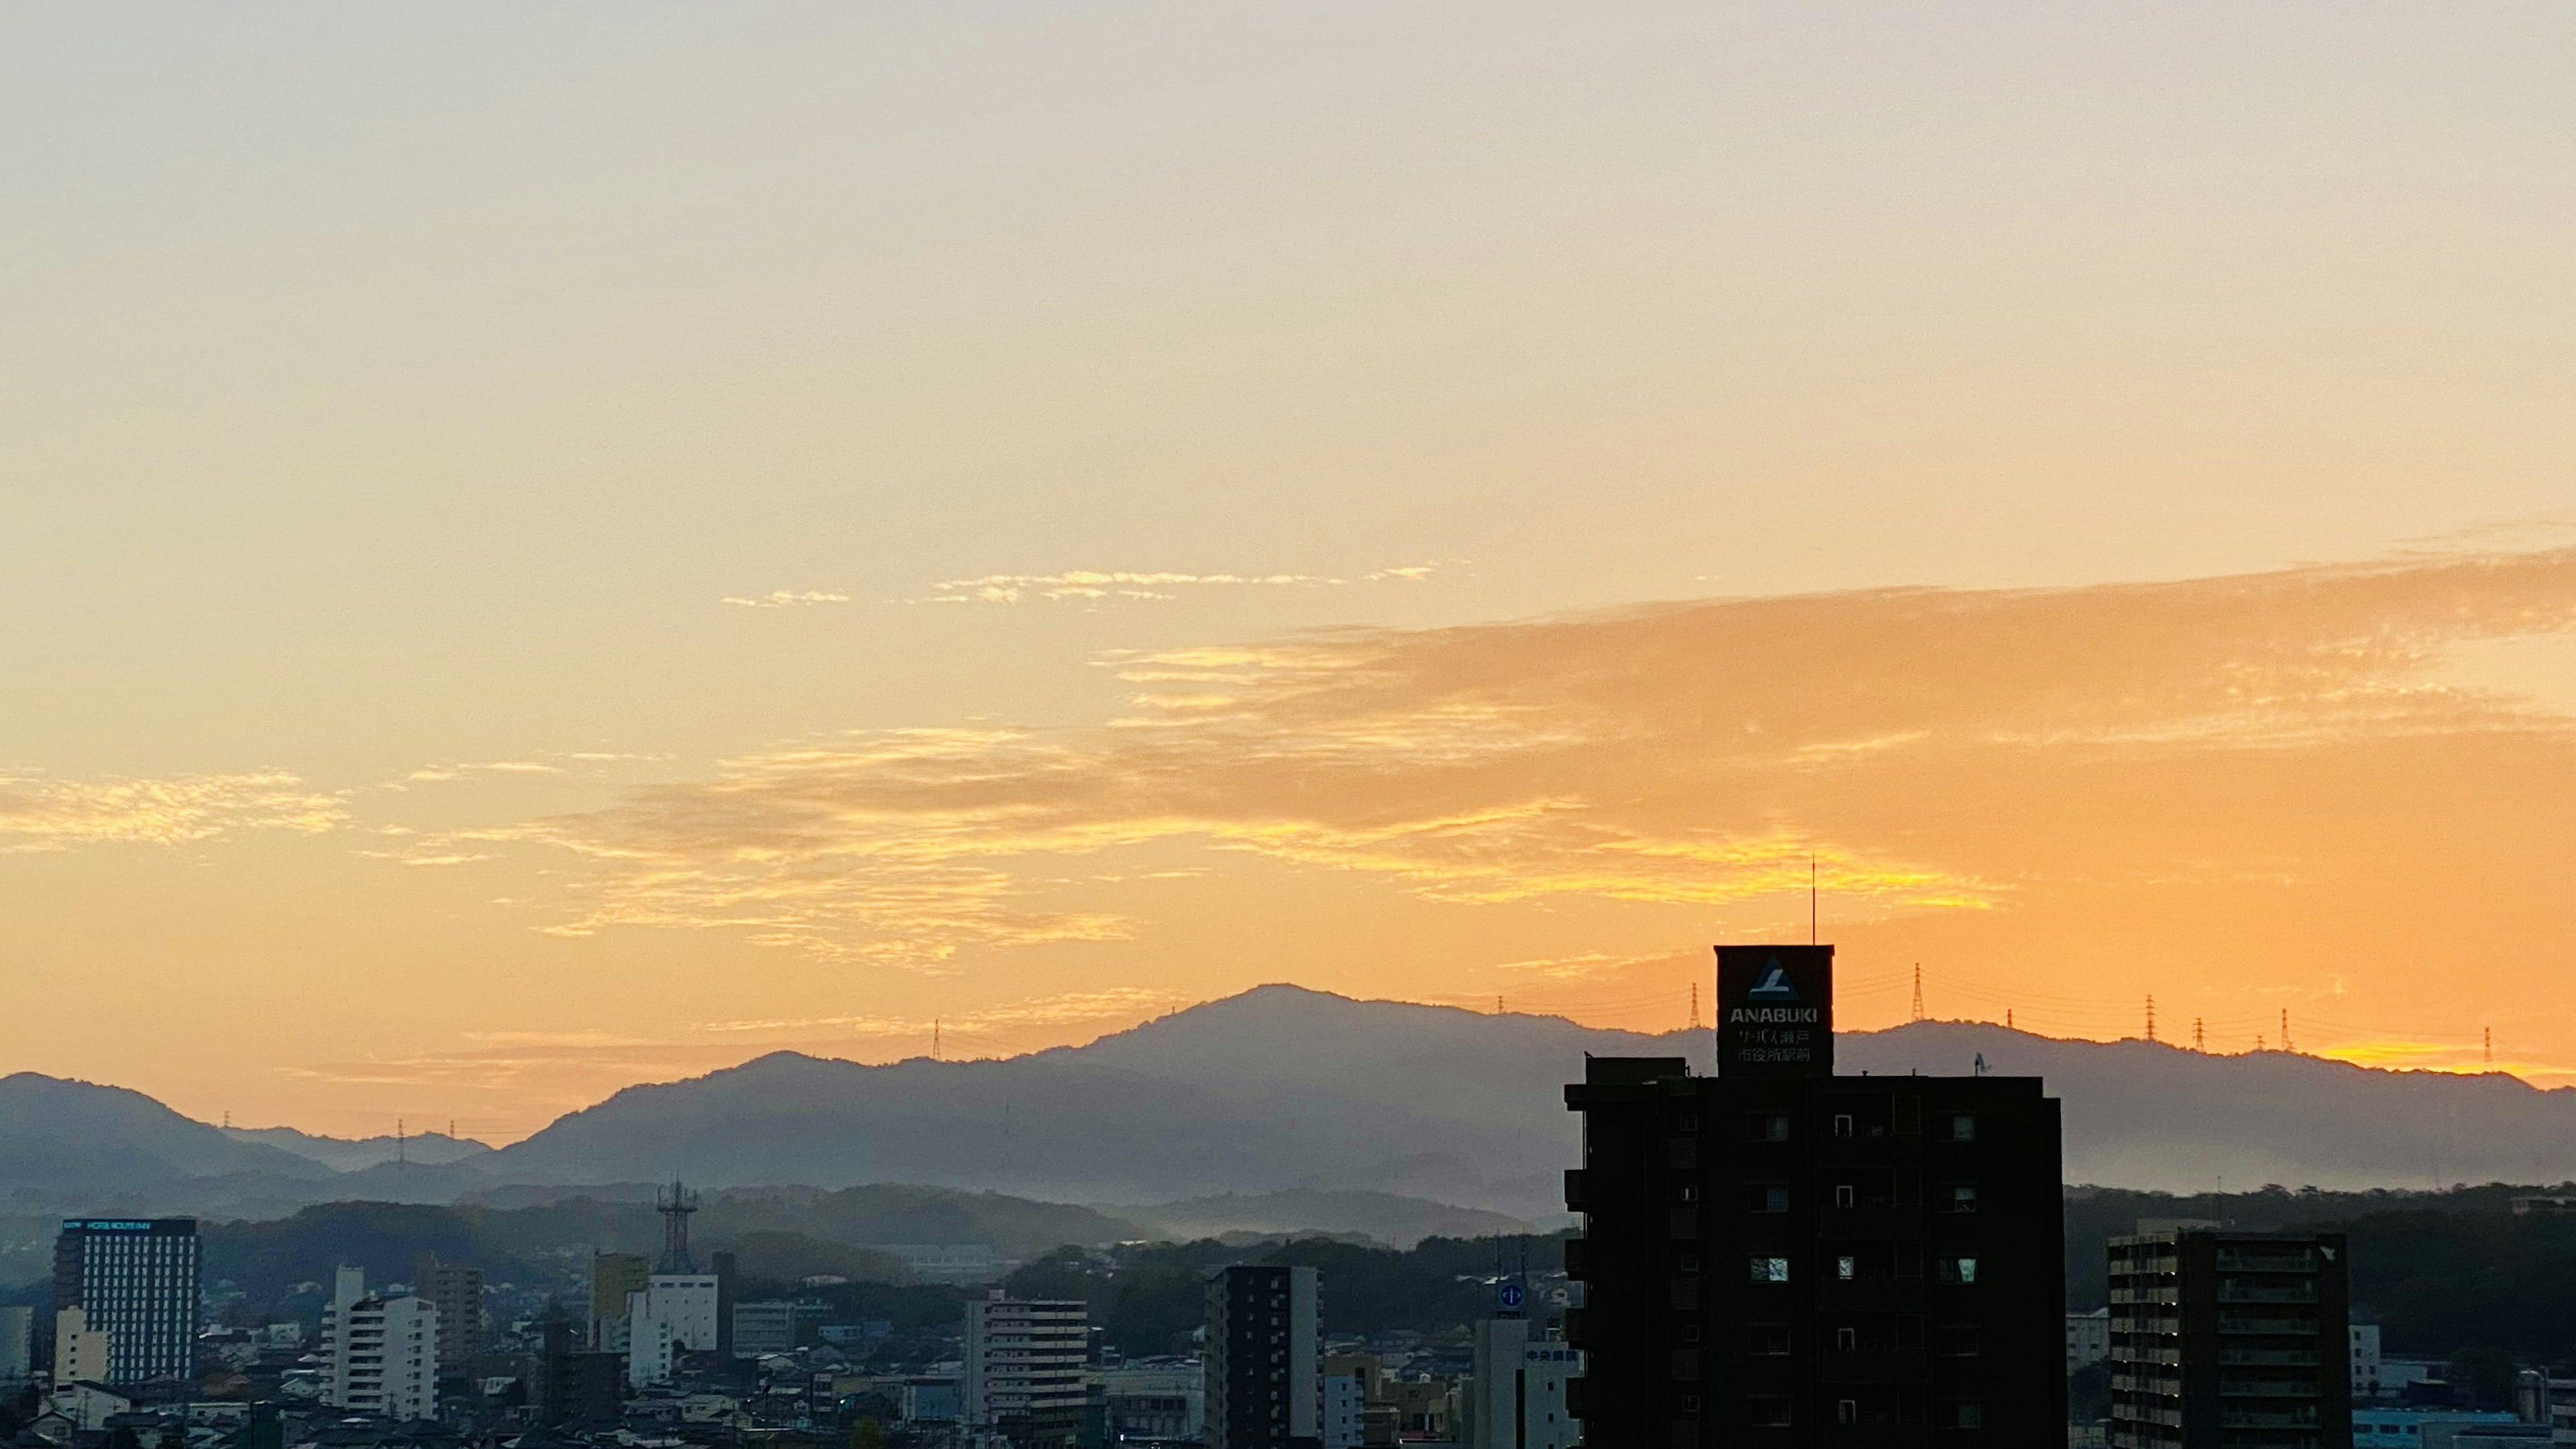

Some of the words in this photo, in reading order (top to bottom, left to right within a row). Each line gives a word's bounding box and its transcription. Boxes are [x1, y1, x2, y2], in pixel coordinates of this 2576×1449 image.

[1730, 1008, 1817, 1022] ANABUKI
[1738, 1047, 1811, 1062] 市役所駅前
